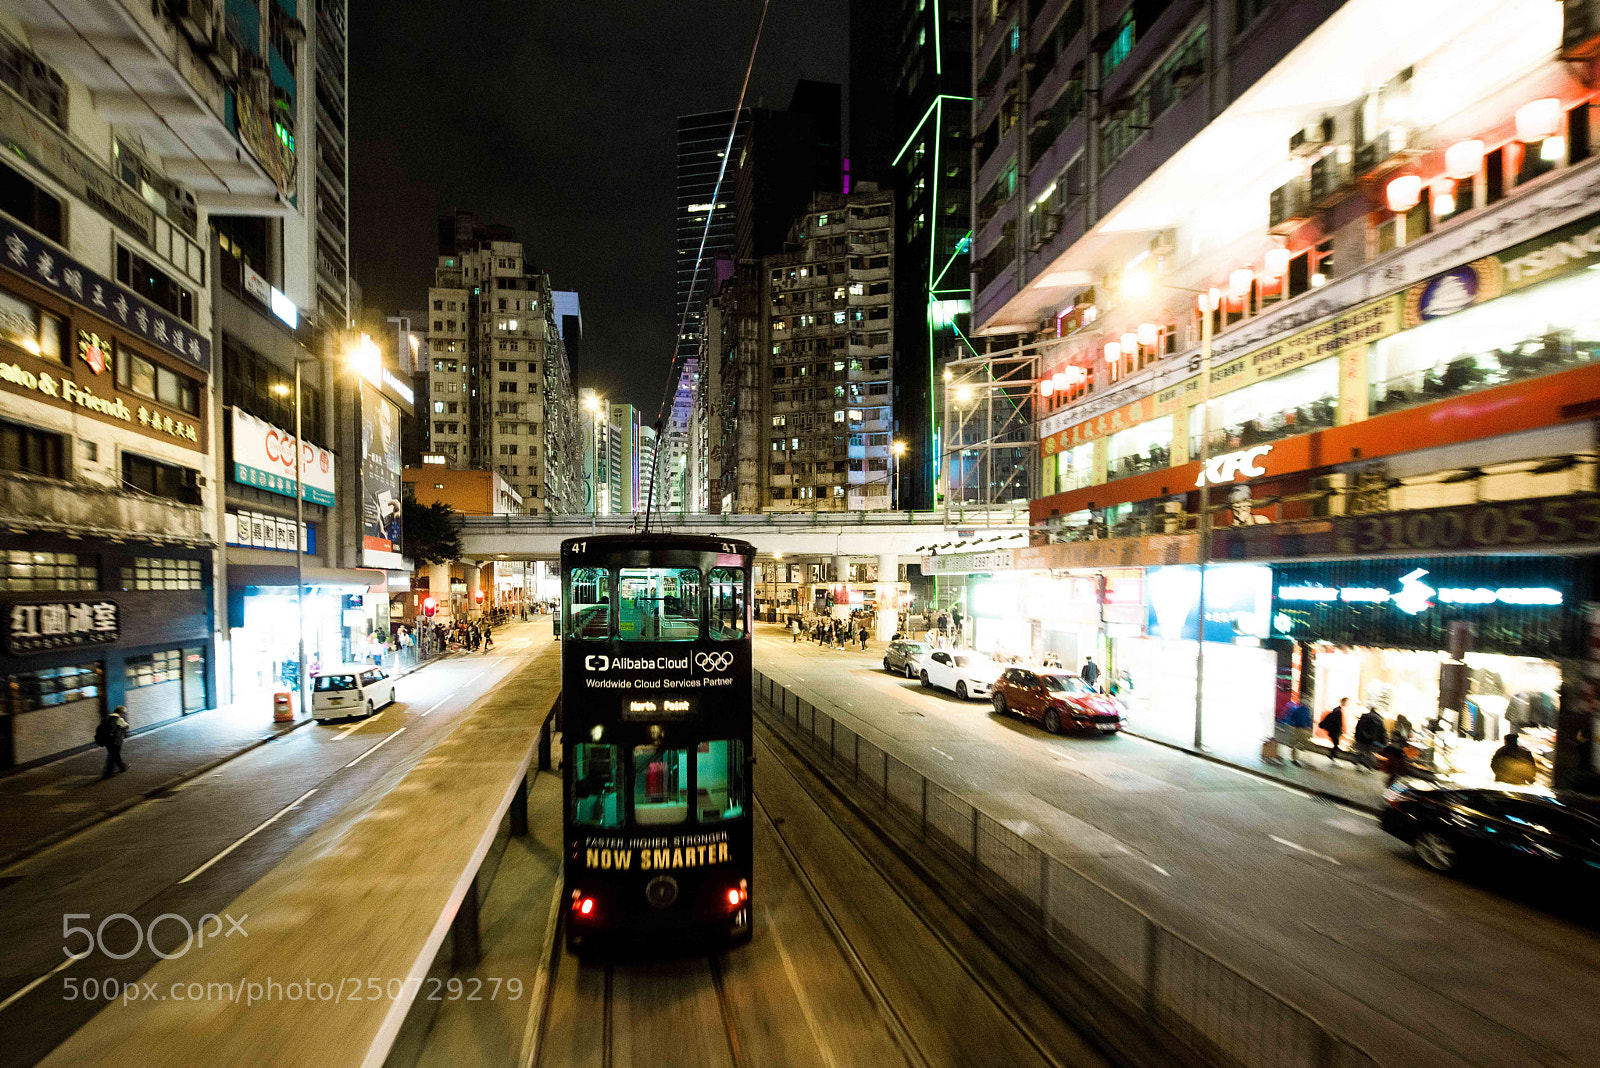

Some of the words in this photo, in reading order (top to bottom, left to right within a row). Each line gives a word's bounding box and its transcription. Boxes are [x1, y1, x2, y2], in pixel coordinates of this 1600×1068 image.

[38, 371, 60, 398] &
[60, 377, 132, 422] Friends
[1195, 444, 1274, 488] KFC
[571, 541, 587, 554] 41
[721, 542, 738, 554] 41
[611, 656, 656, 671] Alibaba
[656, 656, 689, 670] Cloud
[586, 678, 632, 689] Worldwide
[633, 678, 661, 689] Cloud
[663, 677, 702, 689] Services
[703, 676, 734, 687] Partner
[630, 700, 657, 712] North
[663, 700, 690, 711] Point
[586, 847, 632, 871] NOW
[640, 841, 733, 871] SMARTER.
